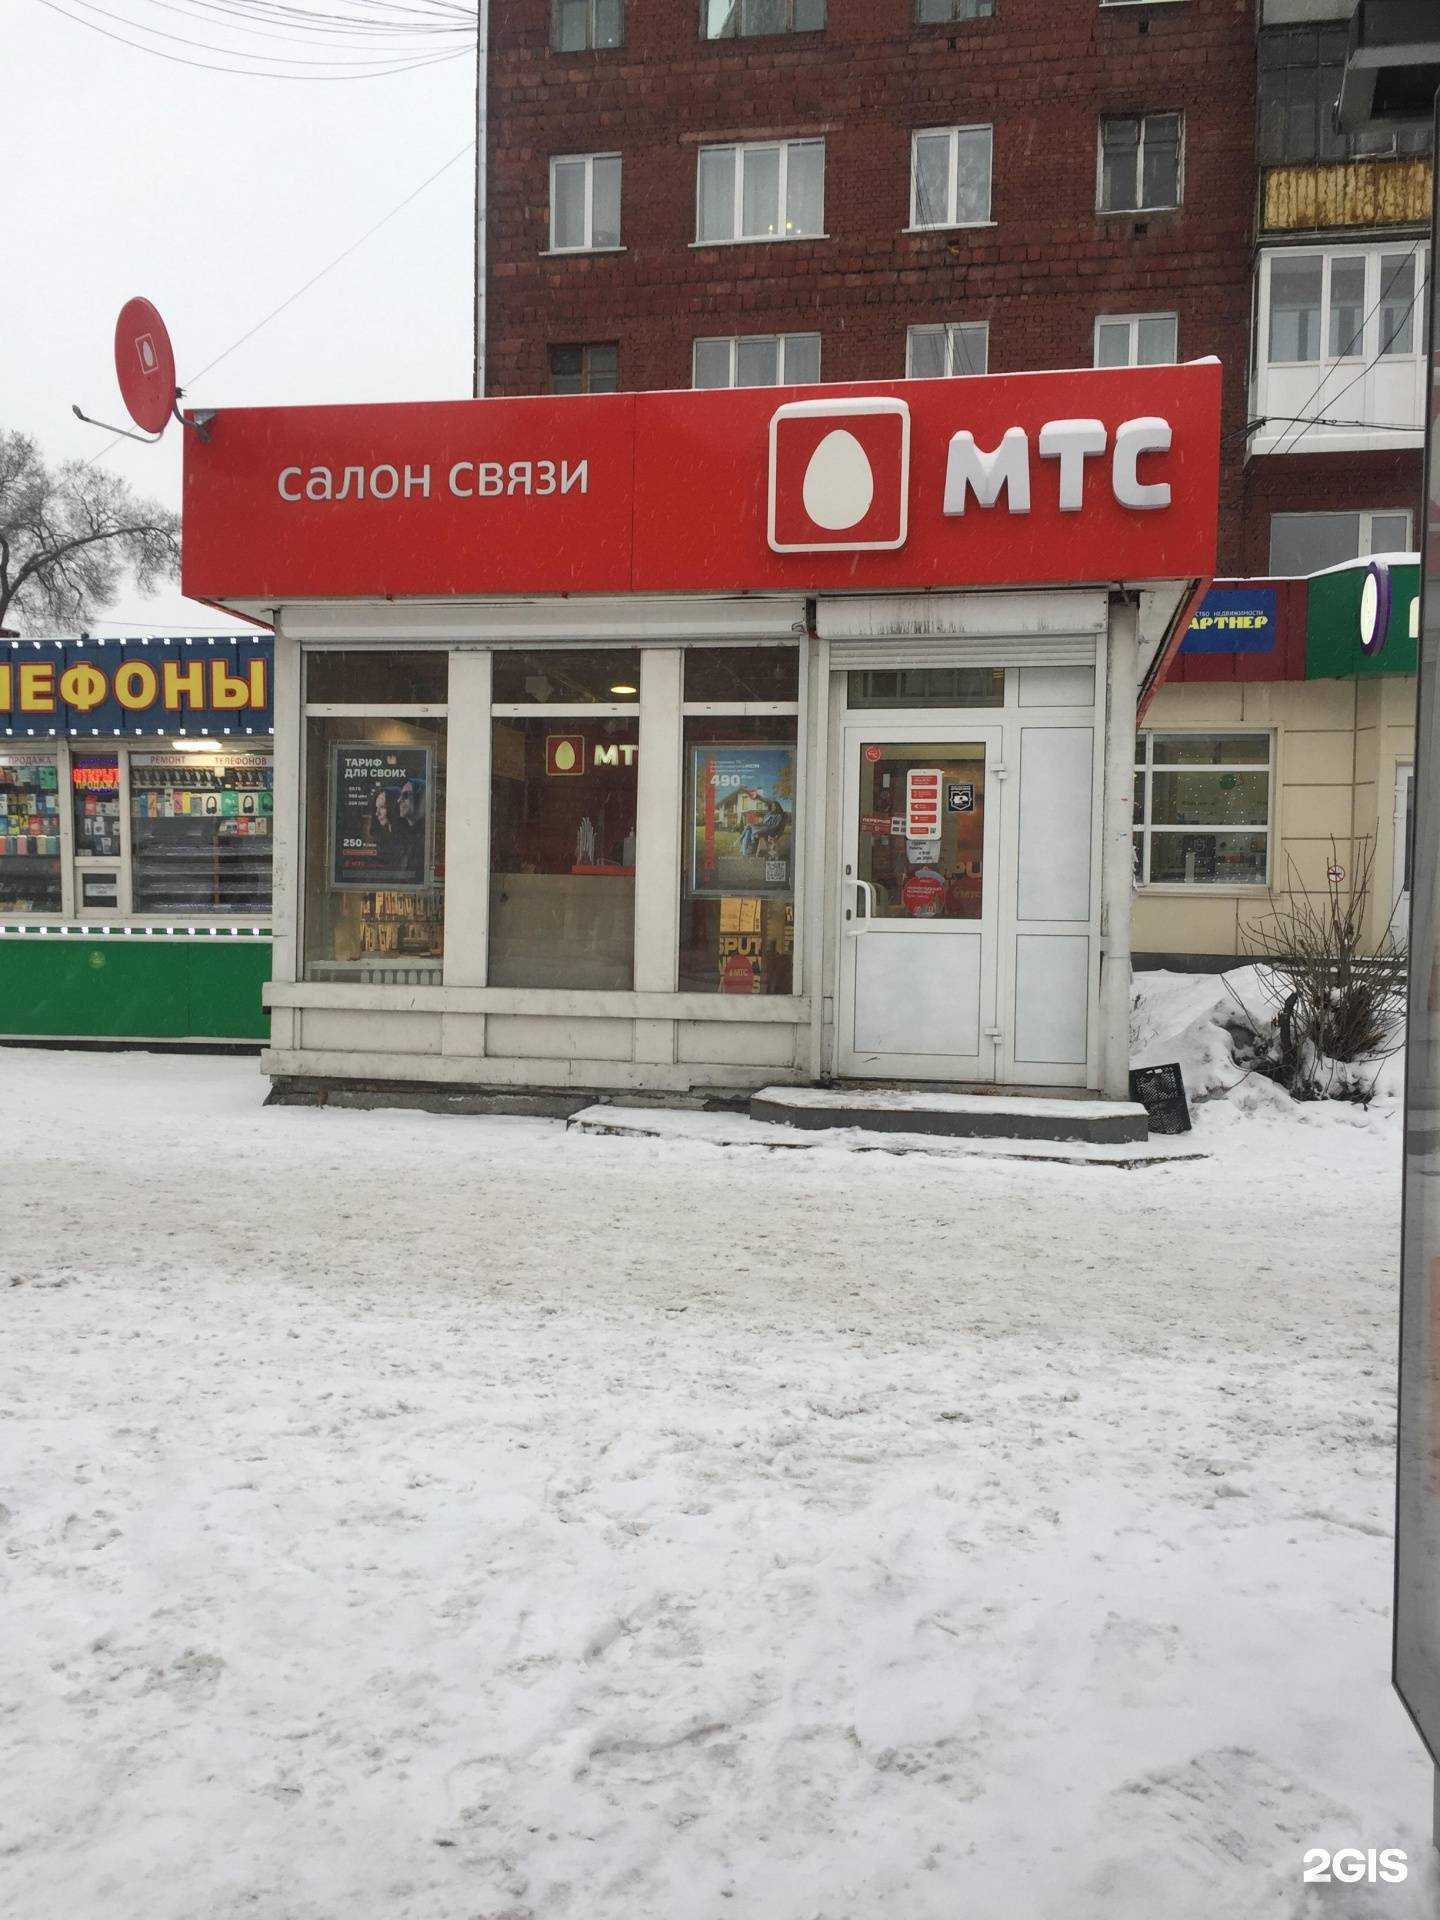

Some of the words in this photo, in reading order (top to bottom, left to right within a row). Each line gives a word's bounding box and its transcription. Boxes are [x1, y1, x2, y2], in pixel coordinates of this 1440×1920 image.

[942, 417, 1173, 515] МТС
[277, 463, 431, 502] салон
[449, 459, 589, 498] связи
[1188, 616, 1269, 630] АРТНЕР
[150, 756, 185, 764] РЕМОНТ
[215, 756, 267, 765] ТЕЛЕФОНОВ
[594, 744, 638, 766] МТ
[344, 758, 382, 767] ТАРИФ
[72, 768, 120, 783] ОТКРЫТ
[344, 768, 367, 779] ДЛЯ
[370, 768, 406, 778] СВОИХ
[710, 774, 740, 786] 490
[343, 838, 362, 847] 250
